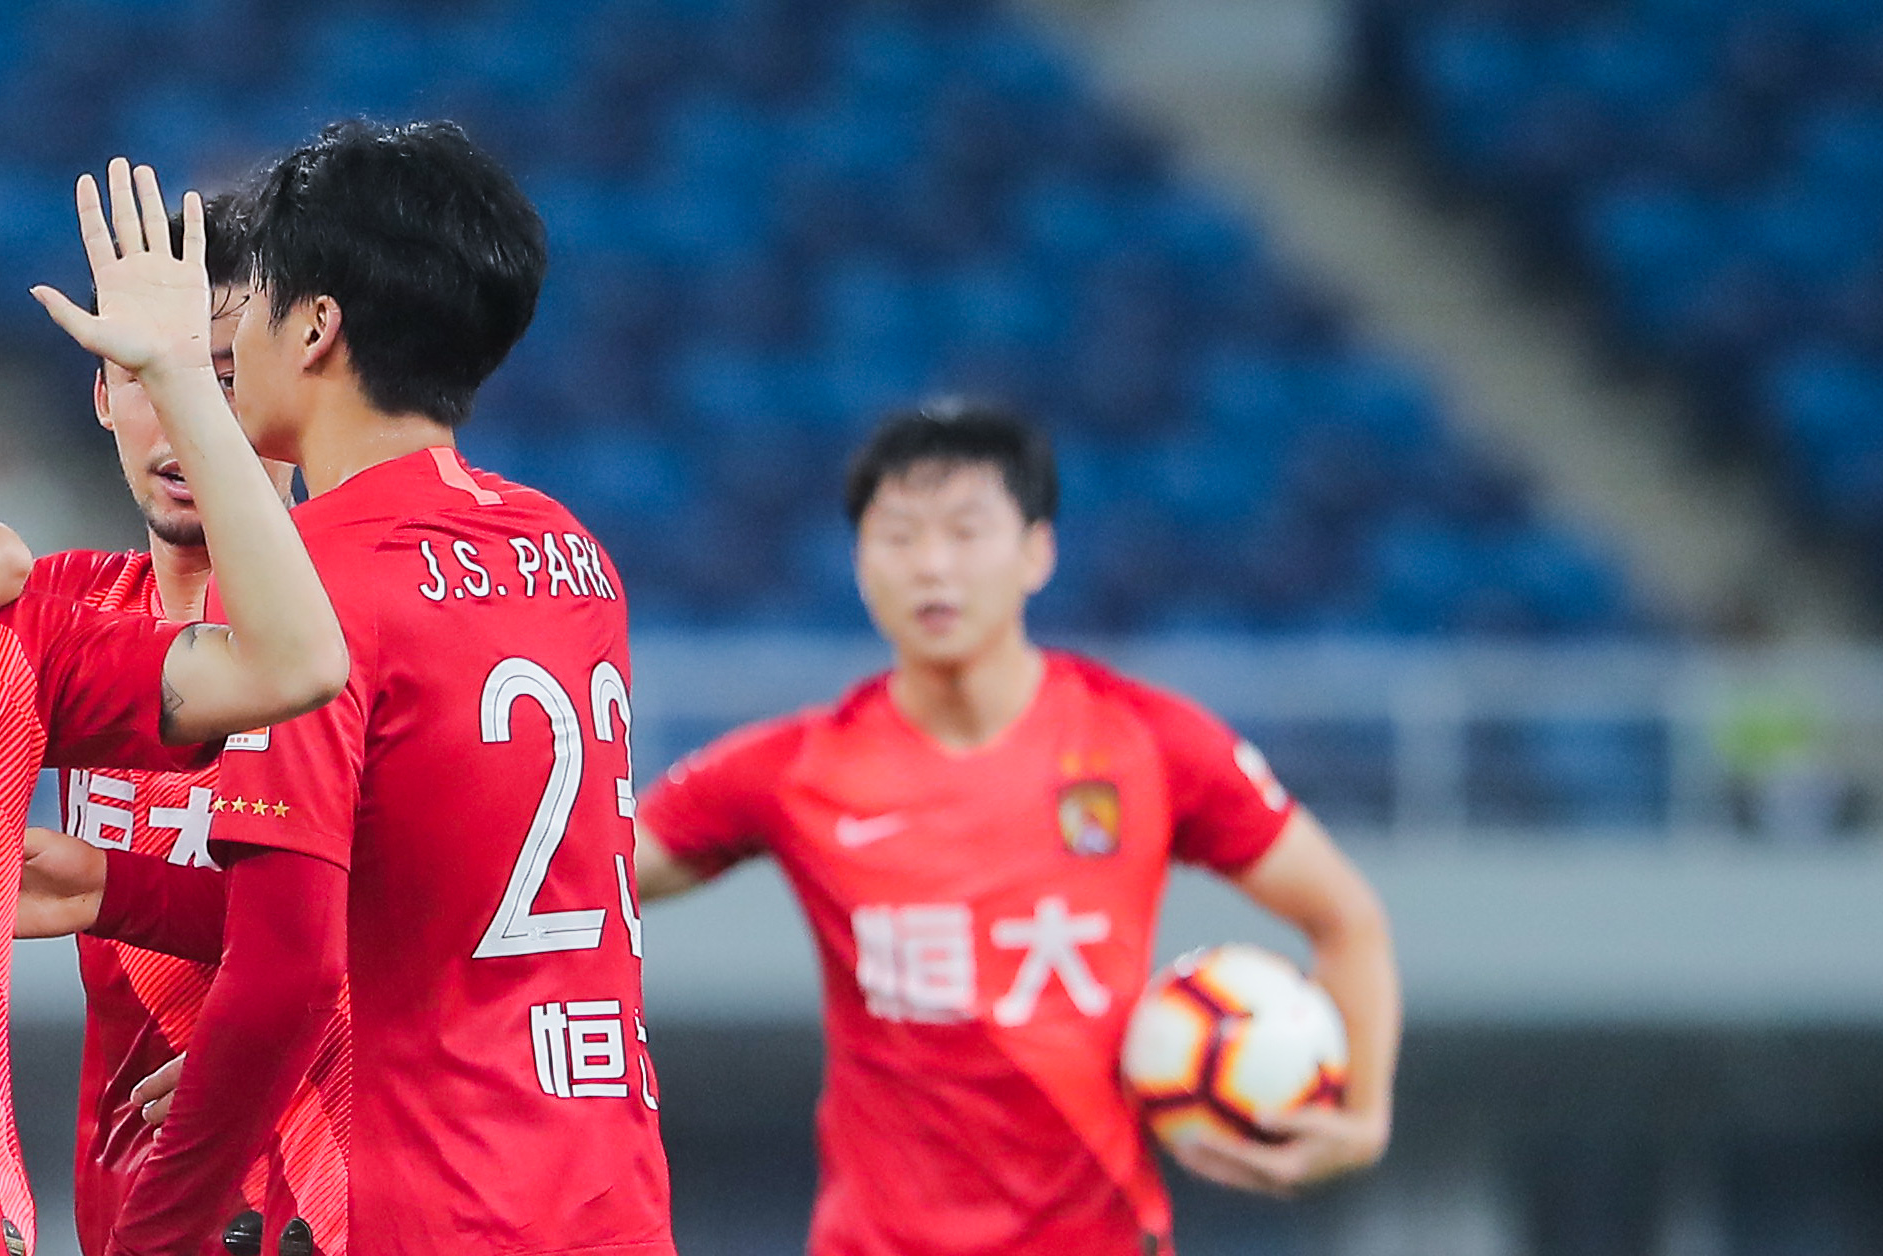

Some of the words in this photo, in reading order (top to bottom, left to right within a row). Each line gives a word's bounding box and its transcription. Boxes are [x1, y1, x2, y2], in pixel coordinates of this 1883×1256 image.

[418, 539, 508, 602] J.S.
[507, 532, 618, 601] PARK
[850, 896, 1113, 1029] 恒大
[529, 999, 659, 1111] 恒
